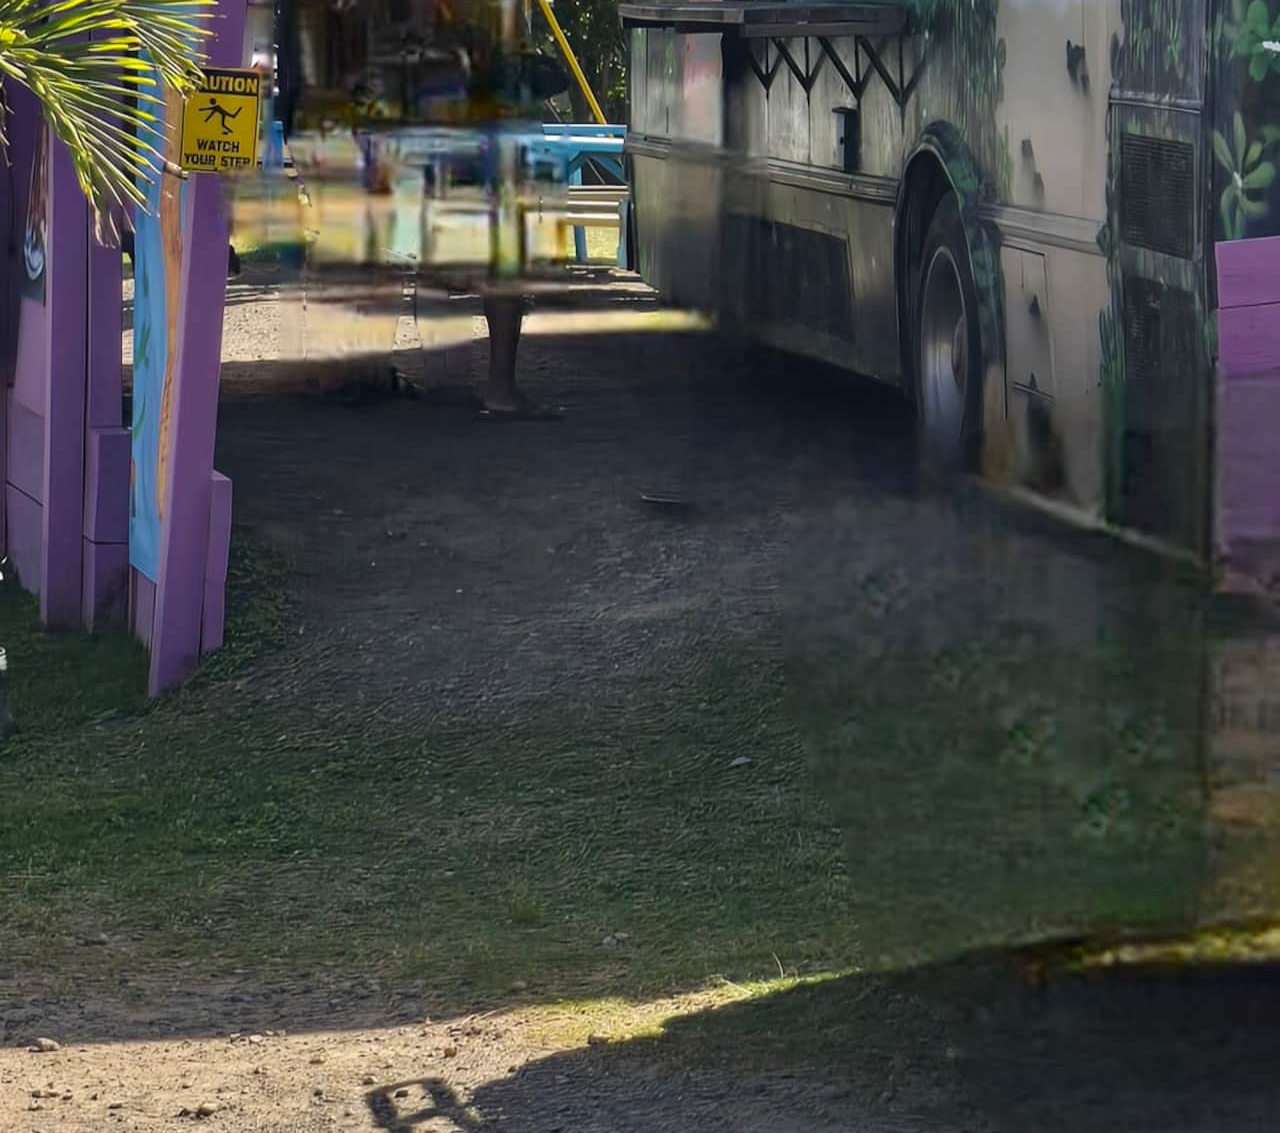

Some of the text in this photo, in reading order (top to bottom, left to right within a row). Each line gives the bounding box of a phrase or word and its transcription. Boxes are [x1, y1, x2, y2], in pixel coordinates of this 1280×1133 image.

[197, 139, 240, 153] WATCH
[184, 153, 251, 167] YOUR STEP
